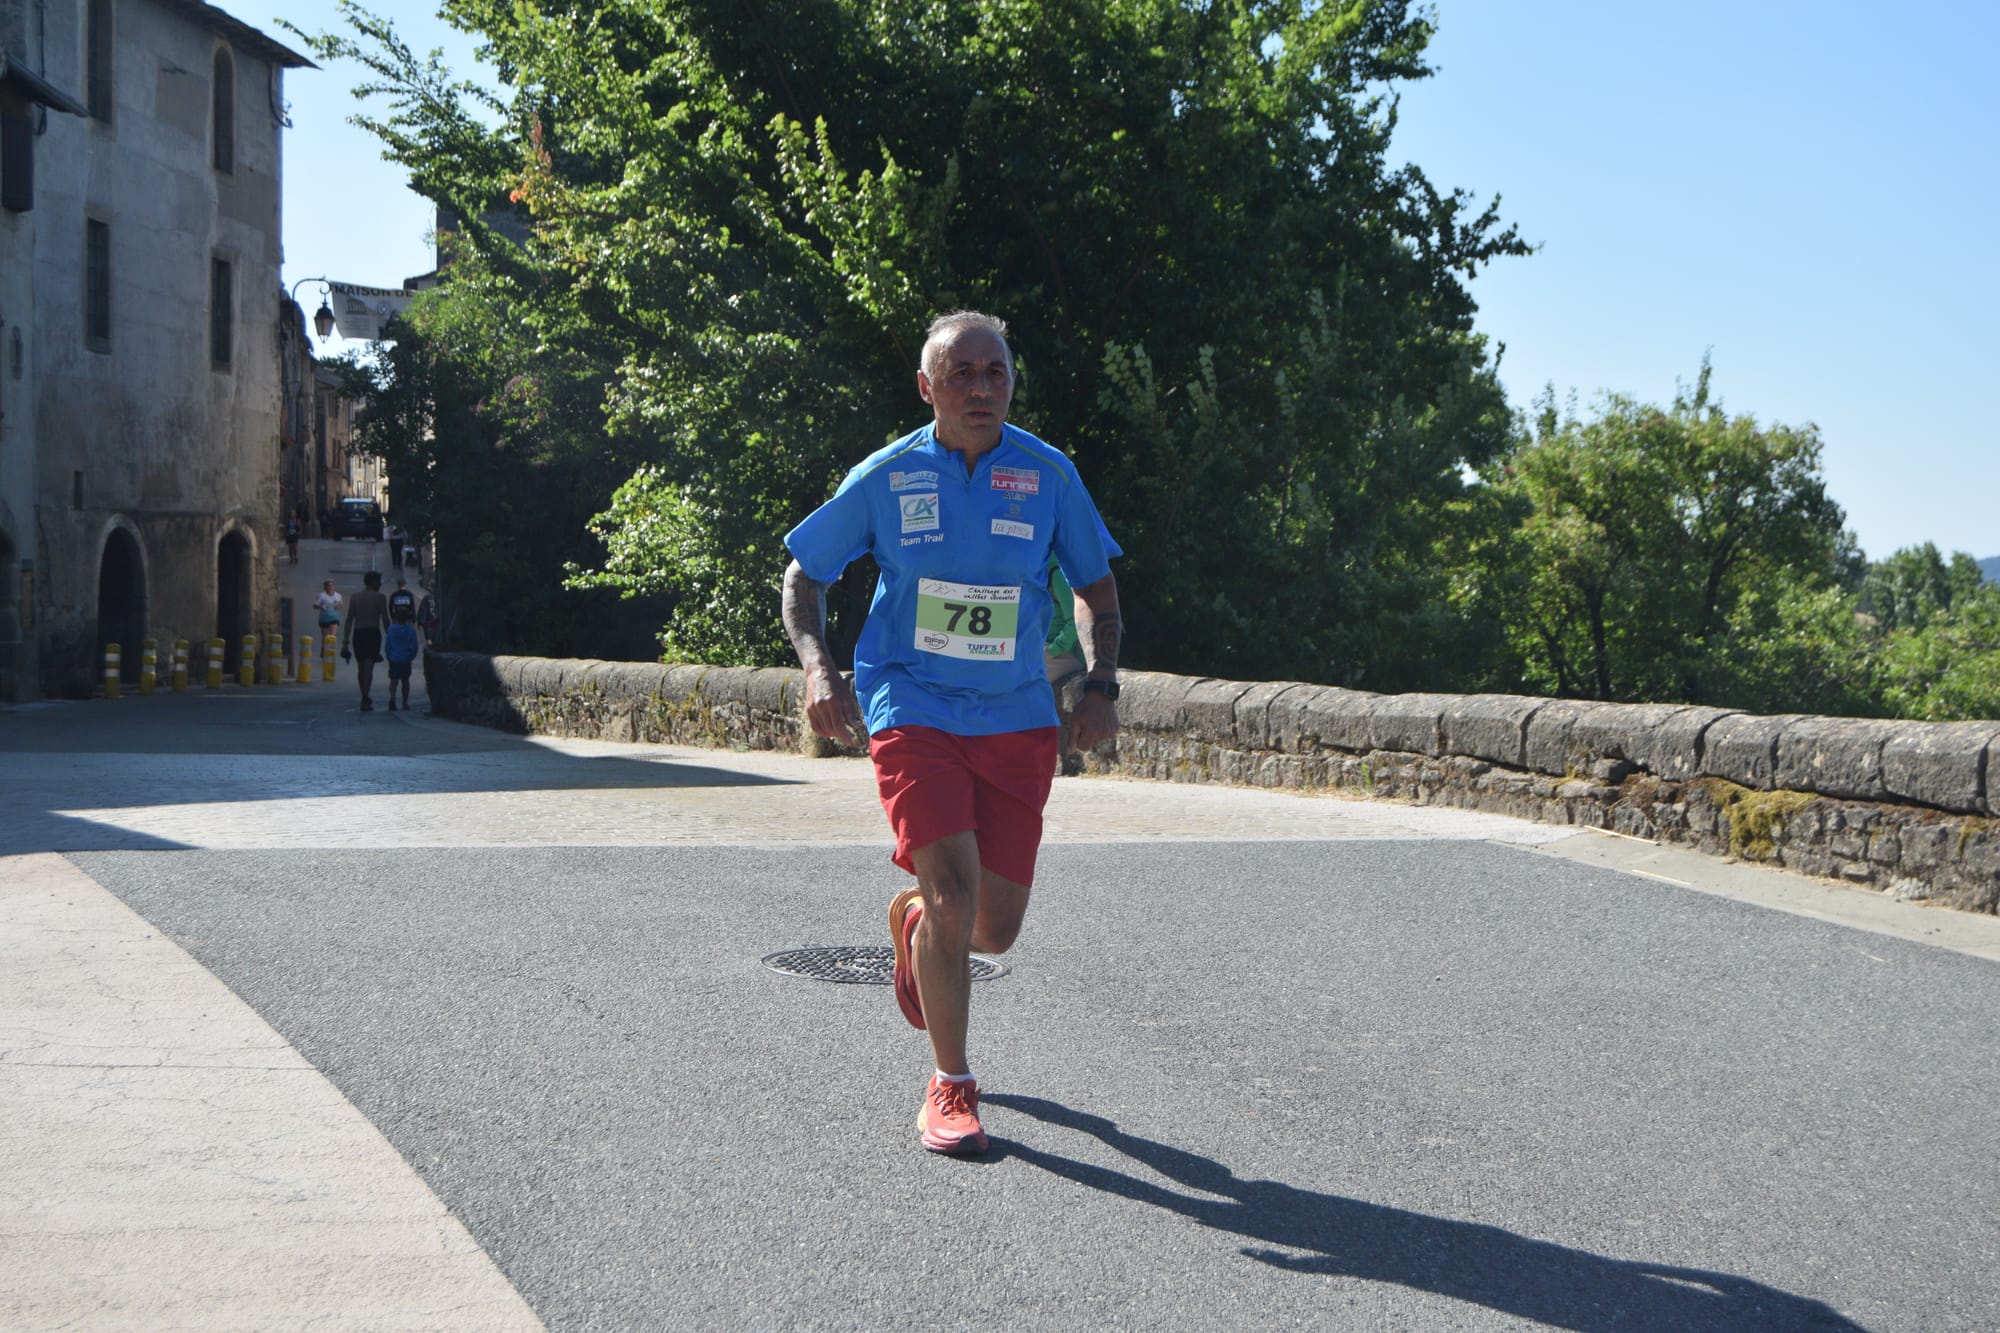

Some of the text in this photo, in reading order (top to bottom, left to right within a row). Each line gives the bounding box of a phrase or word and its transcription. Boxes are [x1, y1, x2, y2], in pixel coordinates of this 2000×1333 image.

[335, 285, 391, 297] MAISON
[900, 533, 944, 549] Team Trail
[944, 603, 992, 636] 78
[967, 643, 997, 651] TUFF'S
